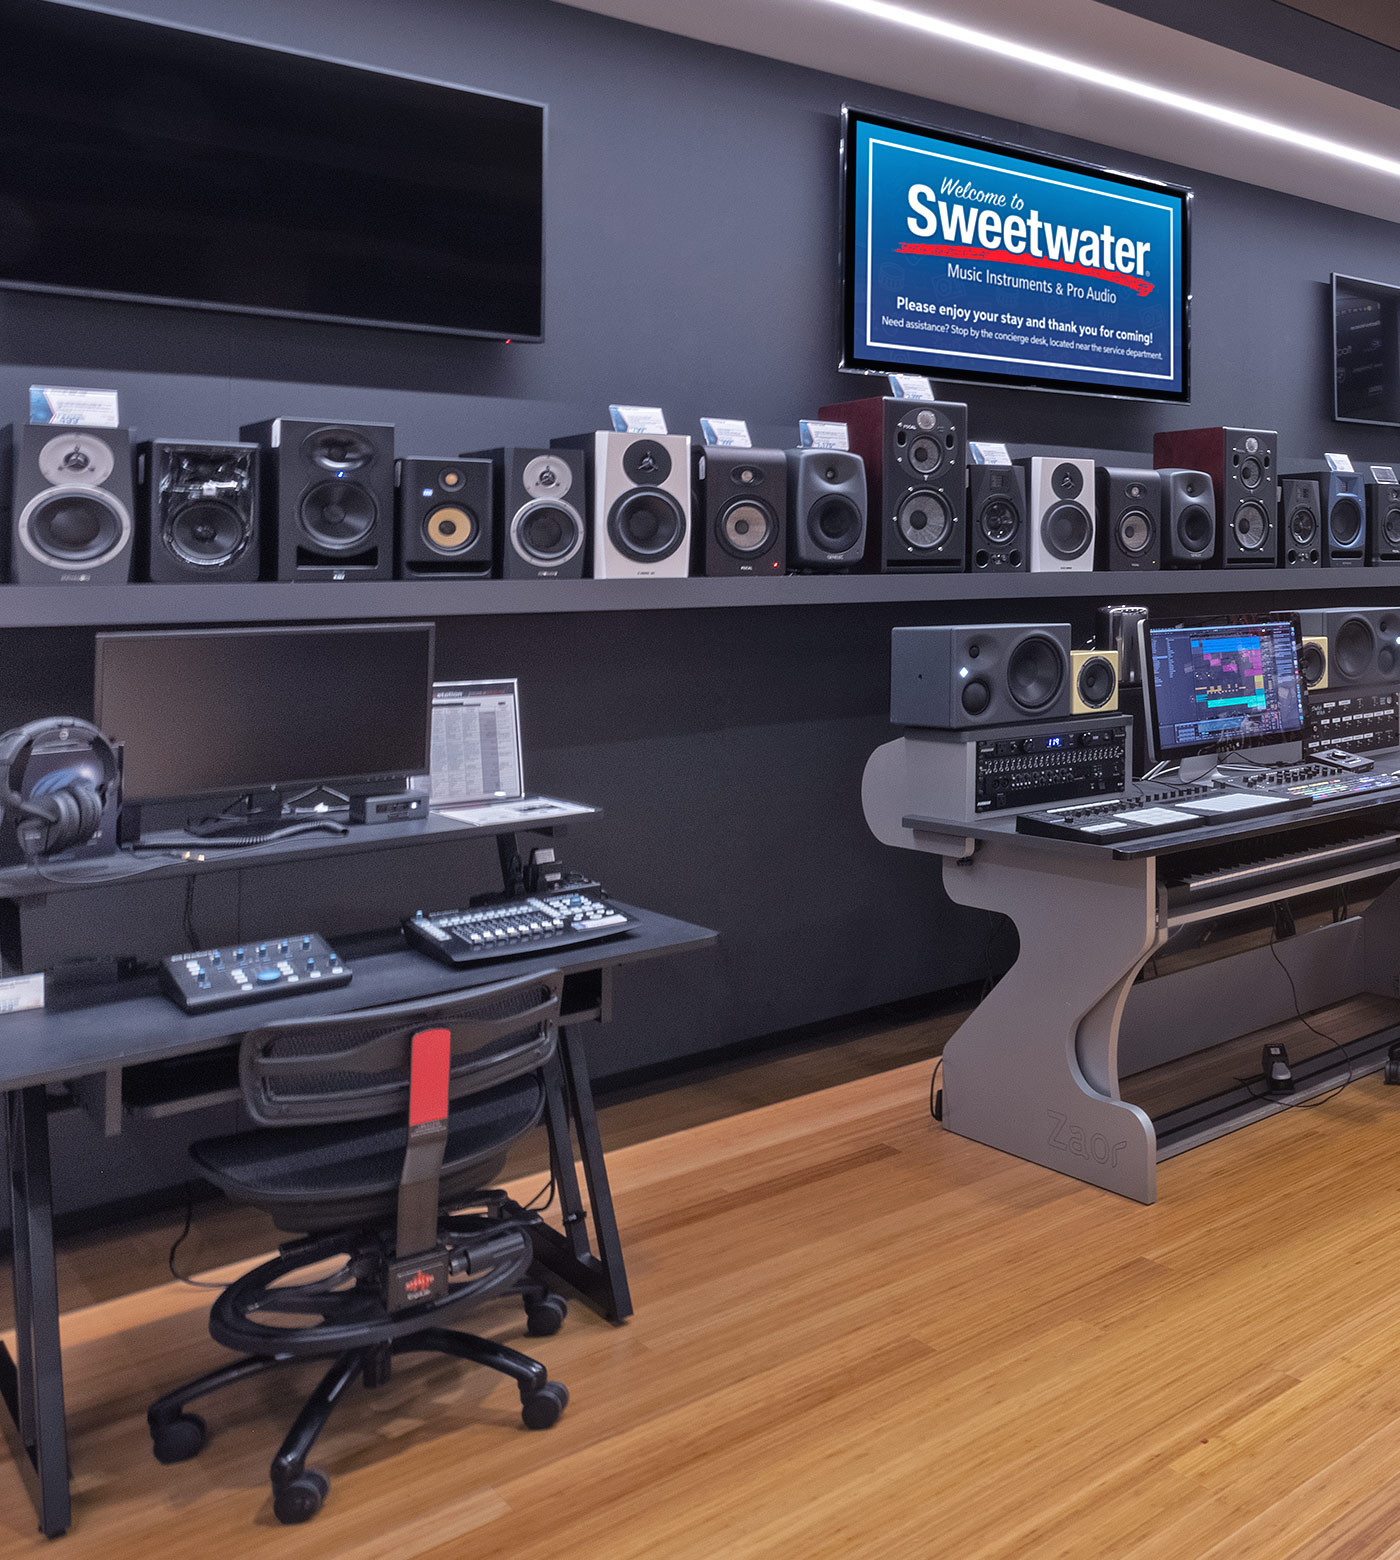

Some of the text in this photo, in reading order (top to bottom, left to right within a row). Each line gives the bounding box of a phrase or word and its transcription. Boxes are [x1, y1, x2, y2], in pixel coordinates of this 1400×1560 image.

[940, 176, 1024, 211] Welcome to
[907, 184, 1150, 277] Sweetwater
[947, 263, 1117, 304] Music Instruments & Pro Audio
[881, 316, 1163, 361] Need assistance? Stop by the concierge desk, located near the service department.
[896, 296, 1153, 346] Please enjoy your stay and thank you for coming!
[1046, 1108, 1127, 1169] Zaor
